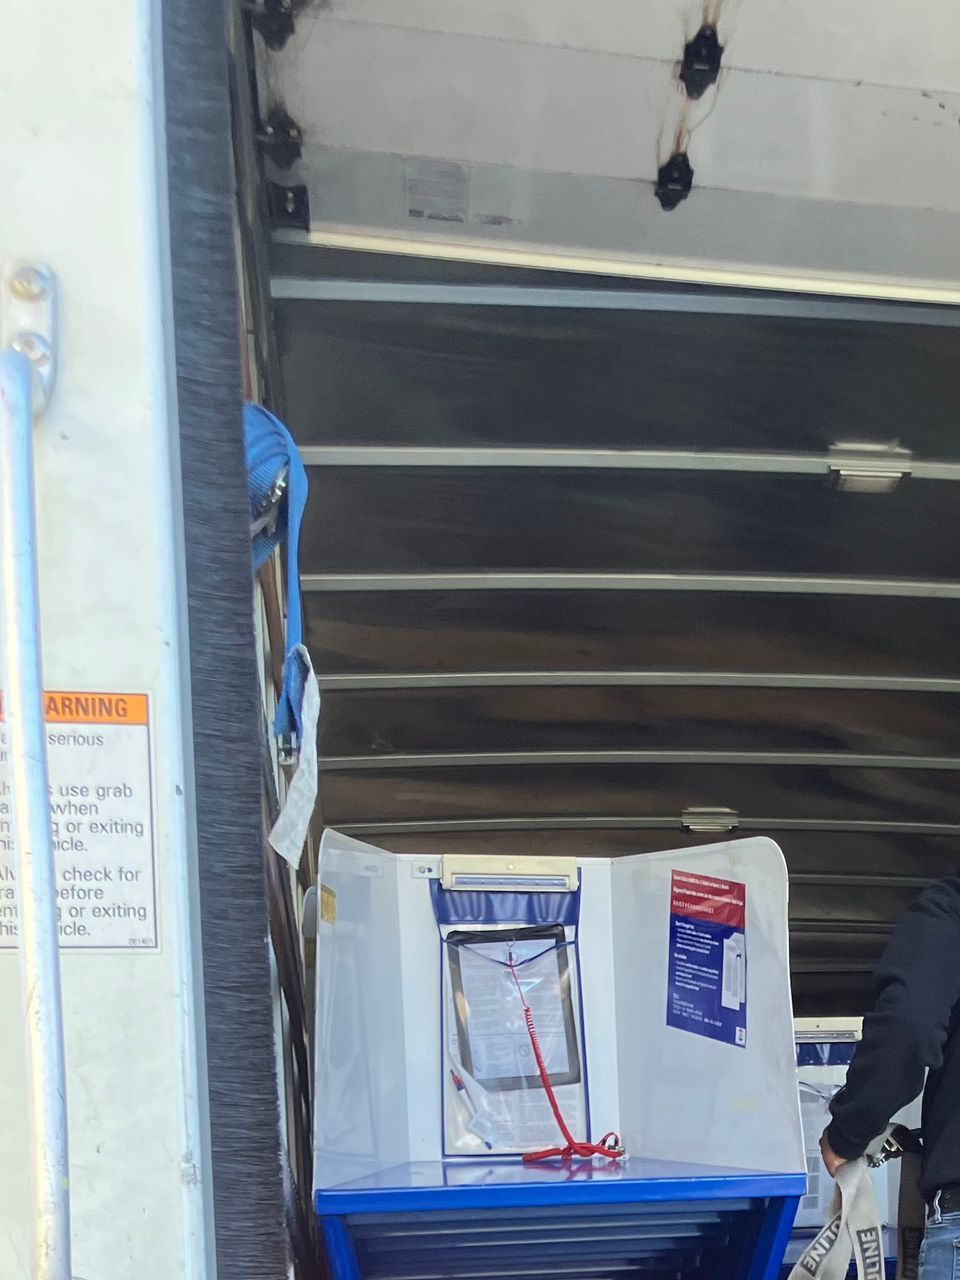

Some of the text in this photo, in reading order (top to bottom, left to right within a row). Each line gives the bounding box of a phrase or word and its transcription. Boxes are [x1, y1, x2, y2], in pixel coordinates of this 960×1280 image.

[45, 696, 129, 719] ARNING
[48, 733, 104, 747] serious
[60, 785, 89, 797] use
[96, 783, 133, 801] grab
[49, 800, 99, 815] when
[66, 822, 83, 833] or
[89, 819, 144, 838] exiting
[63, 866, 142, 882] check for
[69, 906, 86, 917] or
[92, 903, 146, 921] exiting
